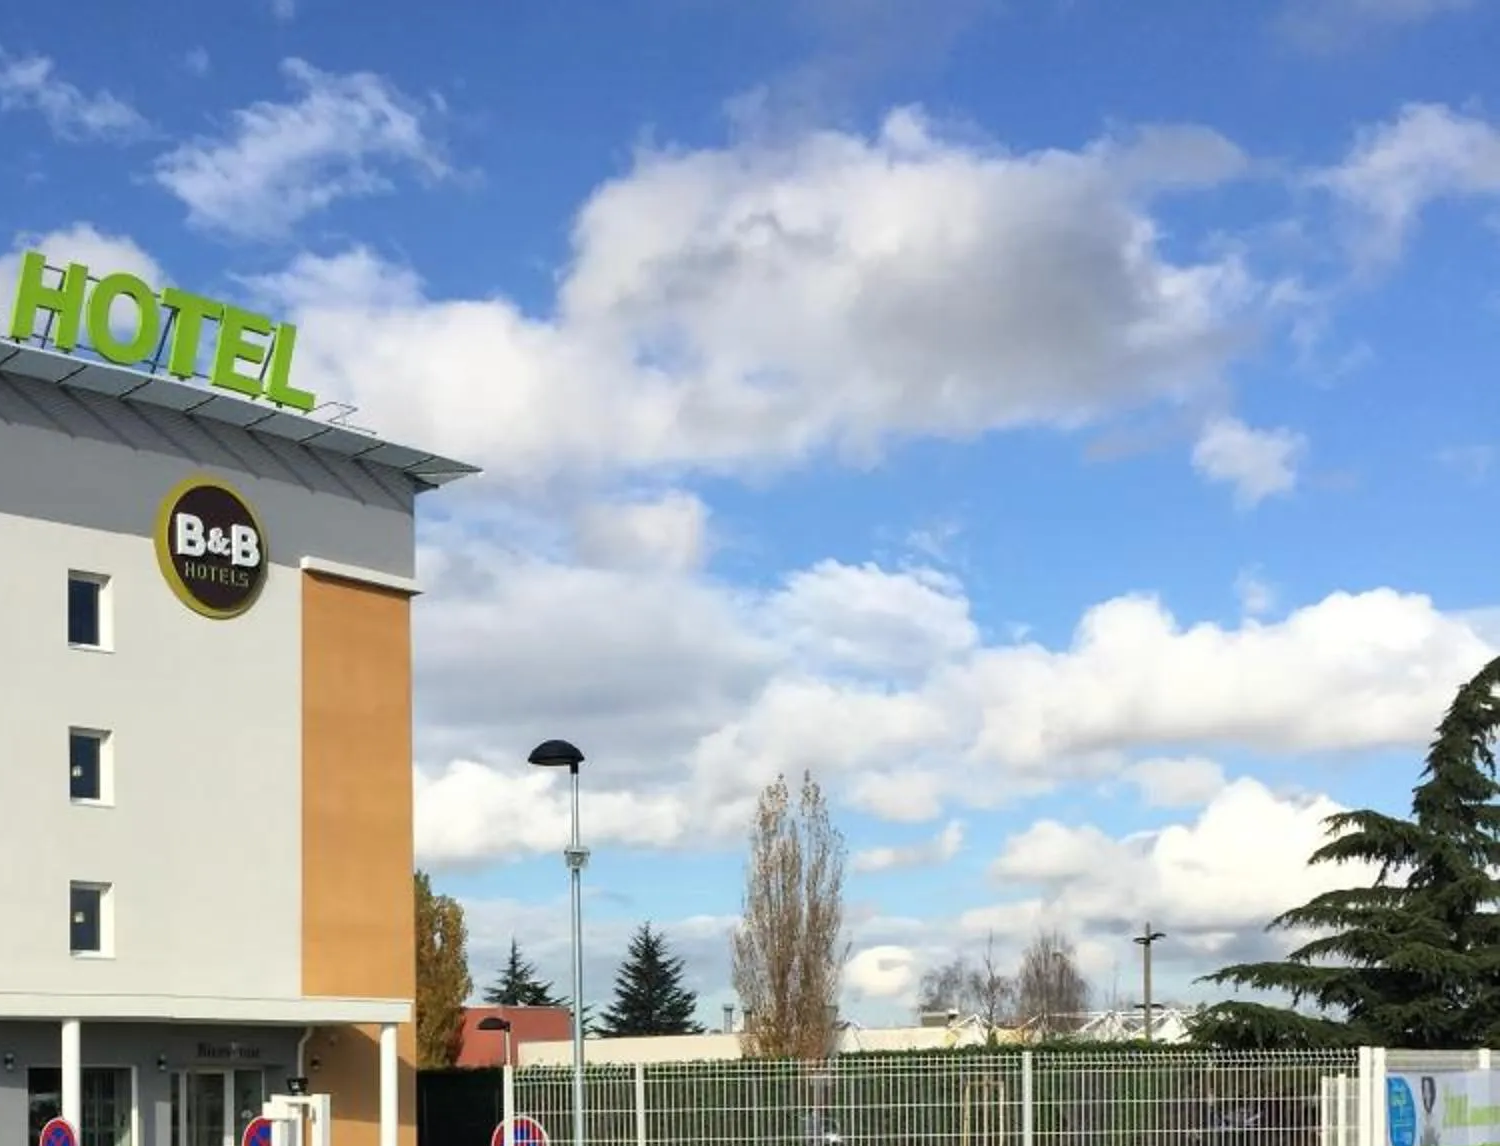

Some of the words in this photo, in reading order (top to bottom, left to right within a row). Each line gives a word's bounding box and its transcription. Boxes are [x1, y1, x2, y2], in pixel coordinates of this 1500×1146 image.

[9, 251, 316, 412] HOTEL
[176, 512, 260, 567] B&B
[185, 561, 249, 588] HOTELS
